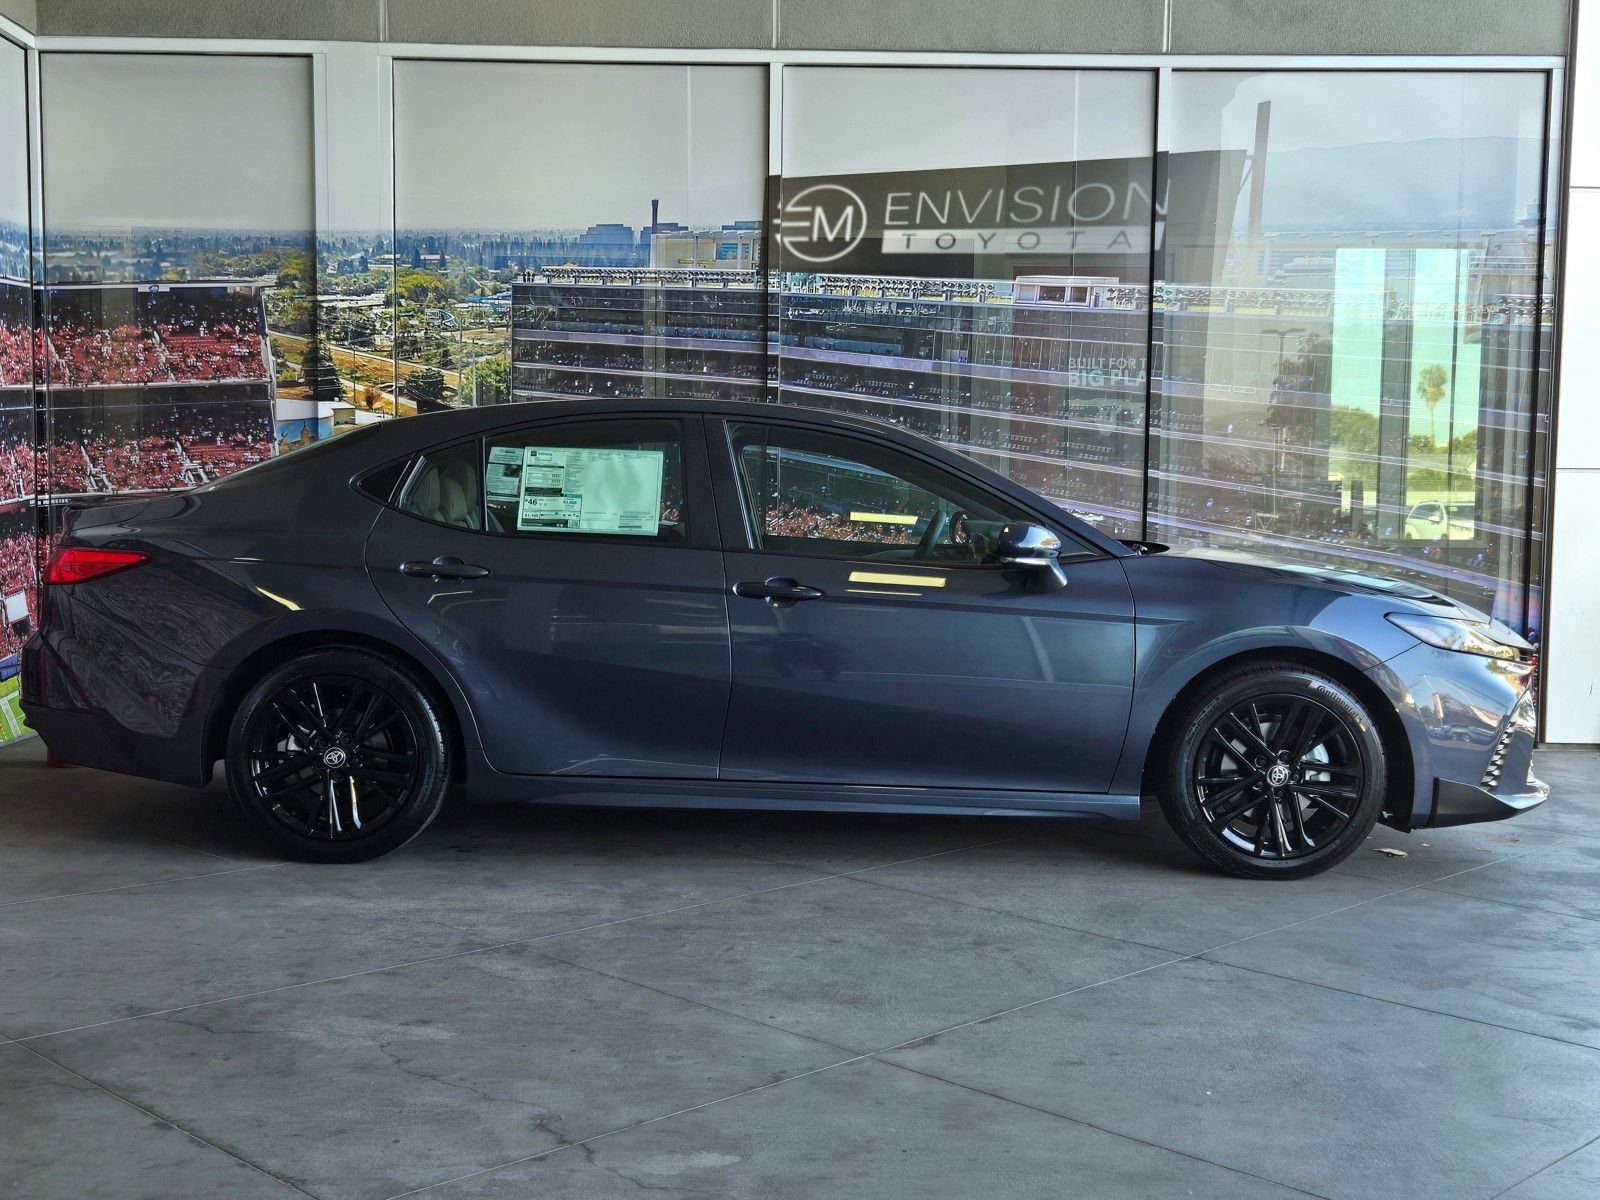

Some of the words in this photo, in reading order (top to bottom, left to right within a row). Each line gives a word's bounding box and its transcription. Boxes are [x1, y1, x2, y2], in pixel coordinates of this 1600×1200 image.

[884, 179, 1171, 225] ENVISION
[902, 230, 1132, 250] TOYOTA
[1069, 358, 1106, 369] BUILT
[1109, 358, 1136, 369] FOR
[1070, 369, 1105, 387] BIG
